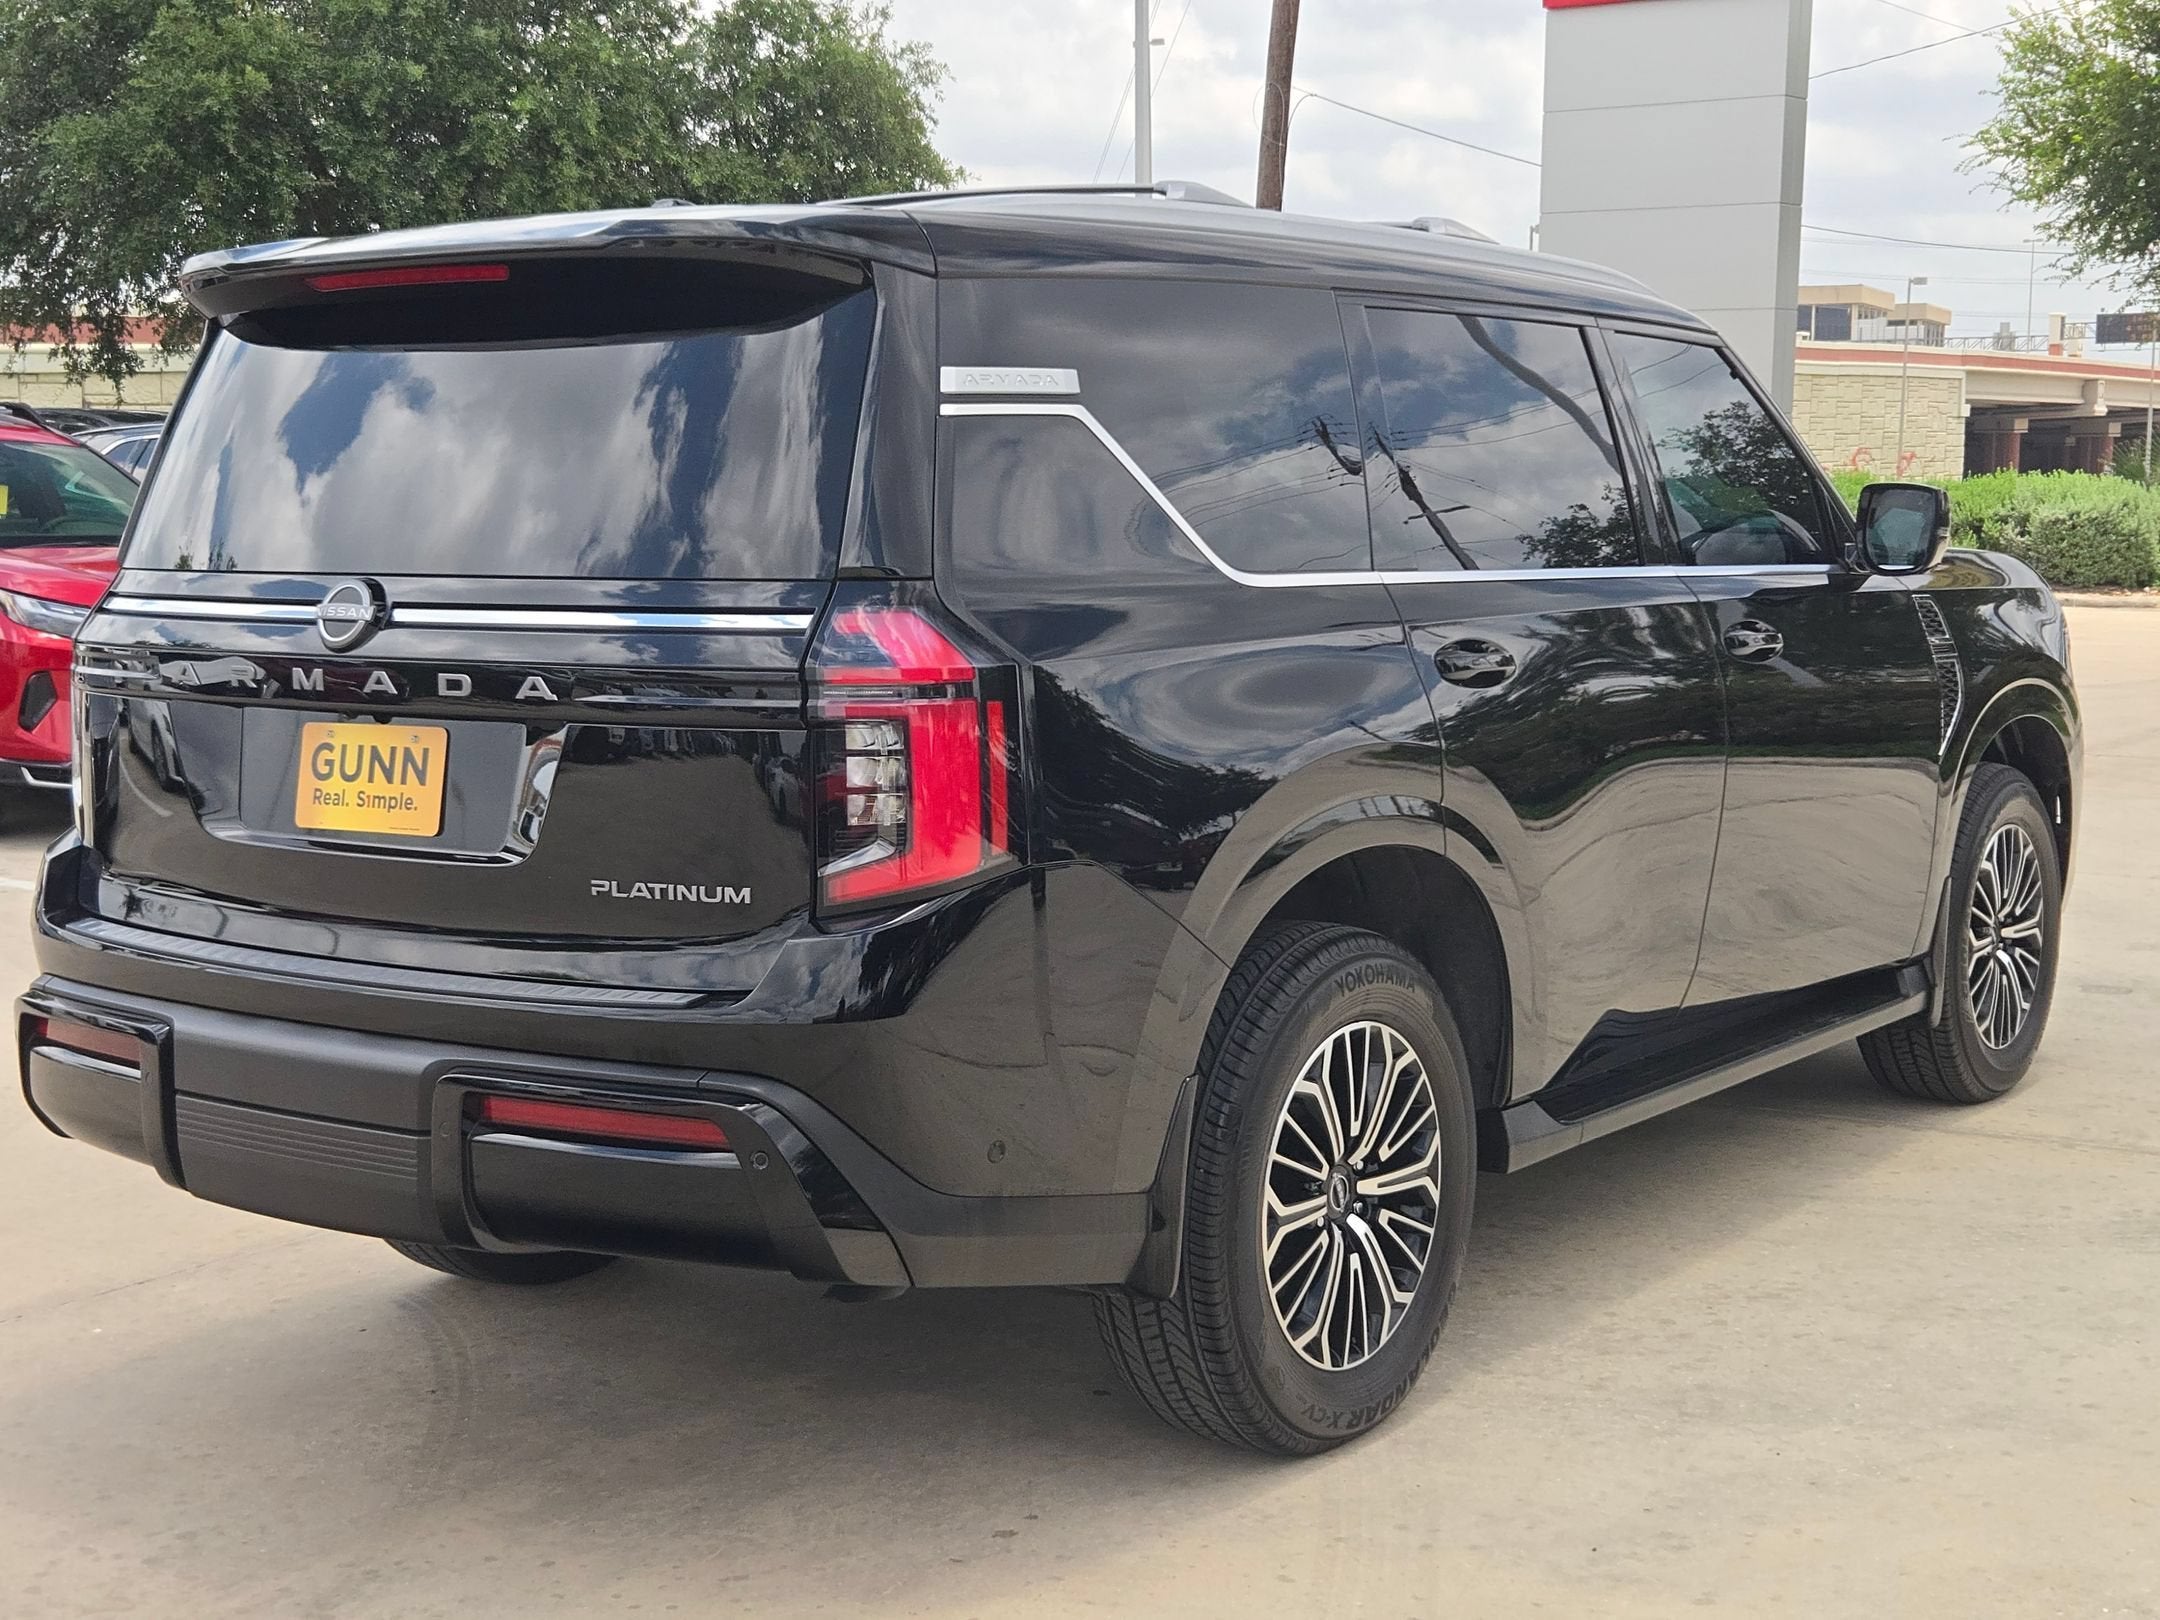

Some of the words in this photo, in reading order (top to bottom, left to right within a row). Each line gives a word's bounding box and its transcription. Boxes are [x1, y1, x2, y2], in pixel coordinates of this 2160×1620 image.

[170, 660, 559, 701] ARMADA
[311, 742, 430, 787] GUNN
[312, 787, 350, 807] Real.
[590, 879, 751, 904] PLATINUM
[1334, 963, 1416, 997] YOKOHAMA
